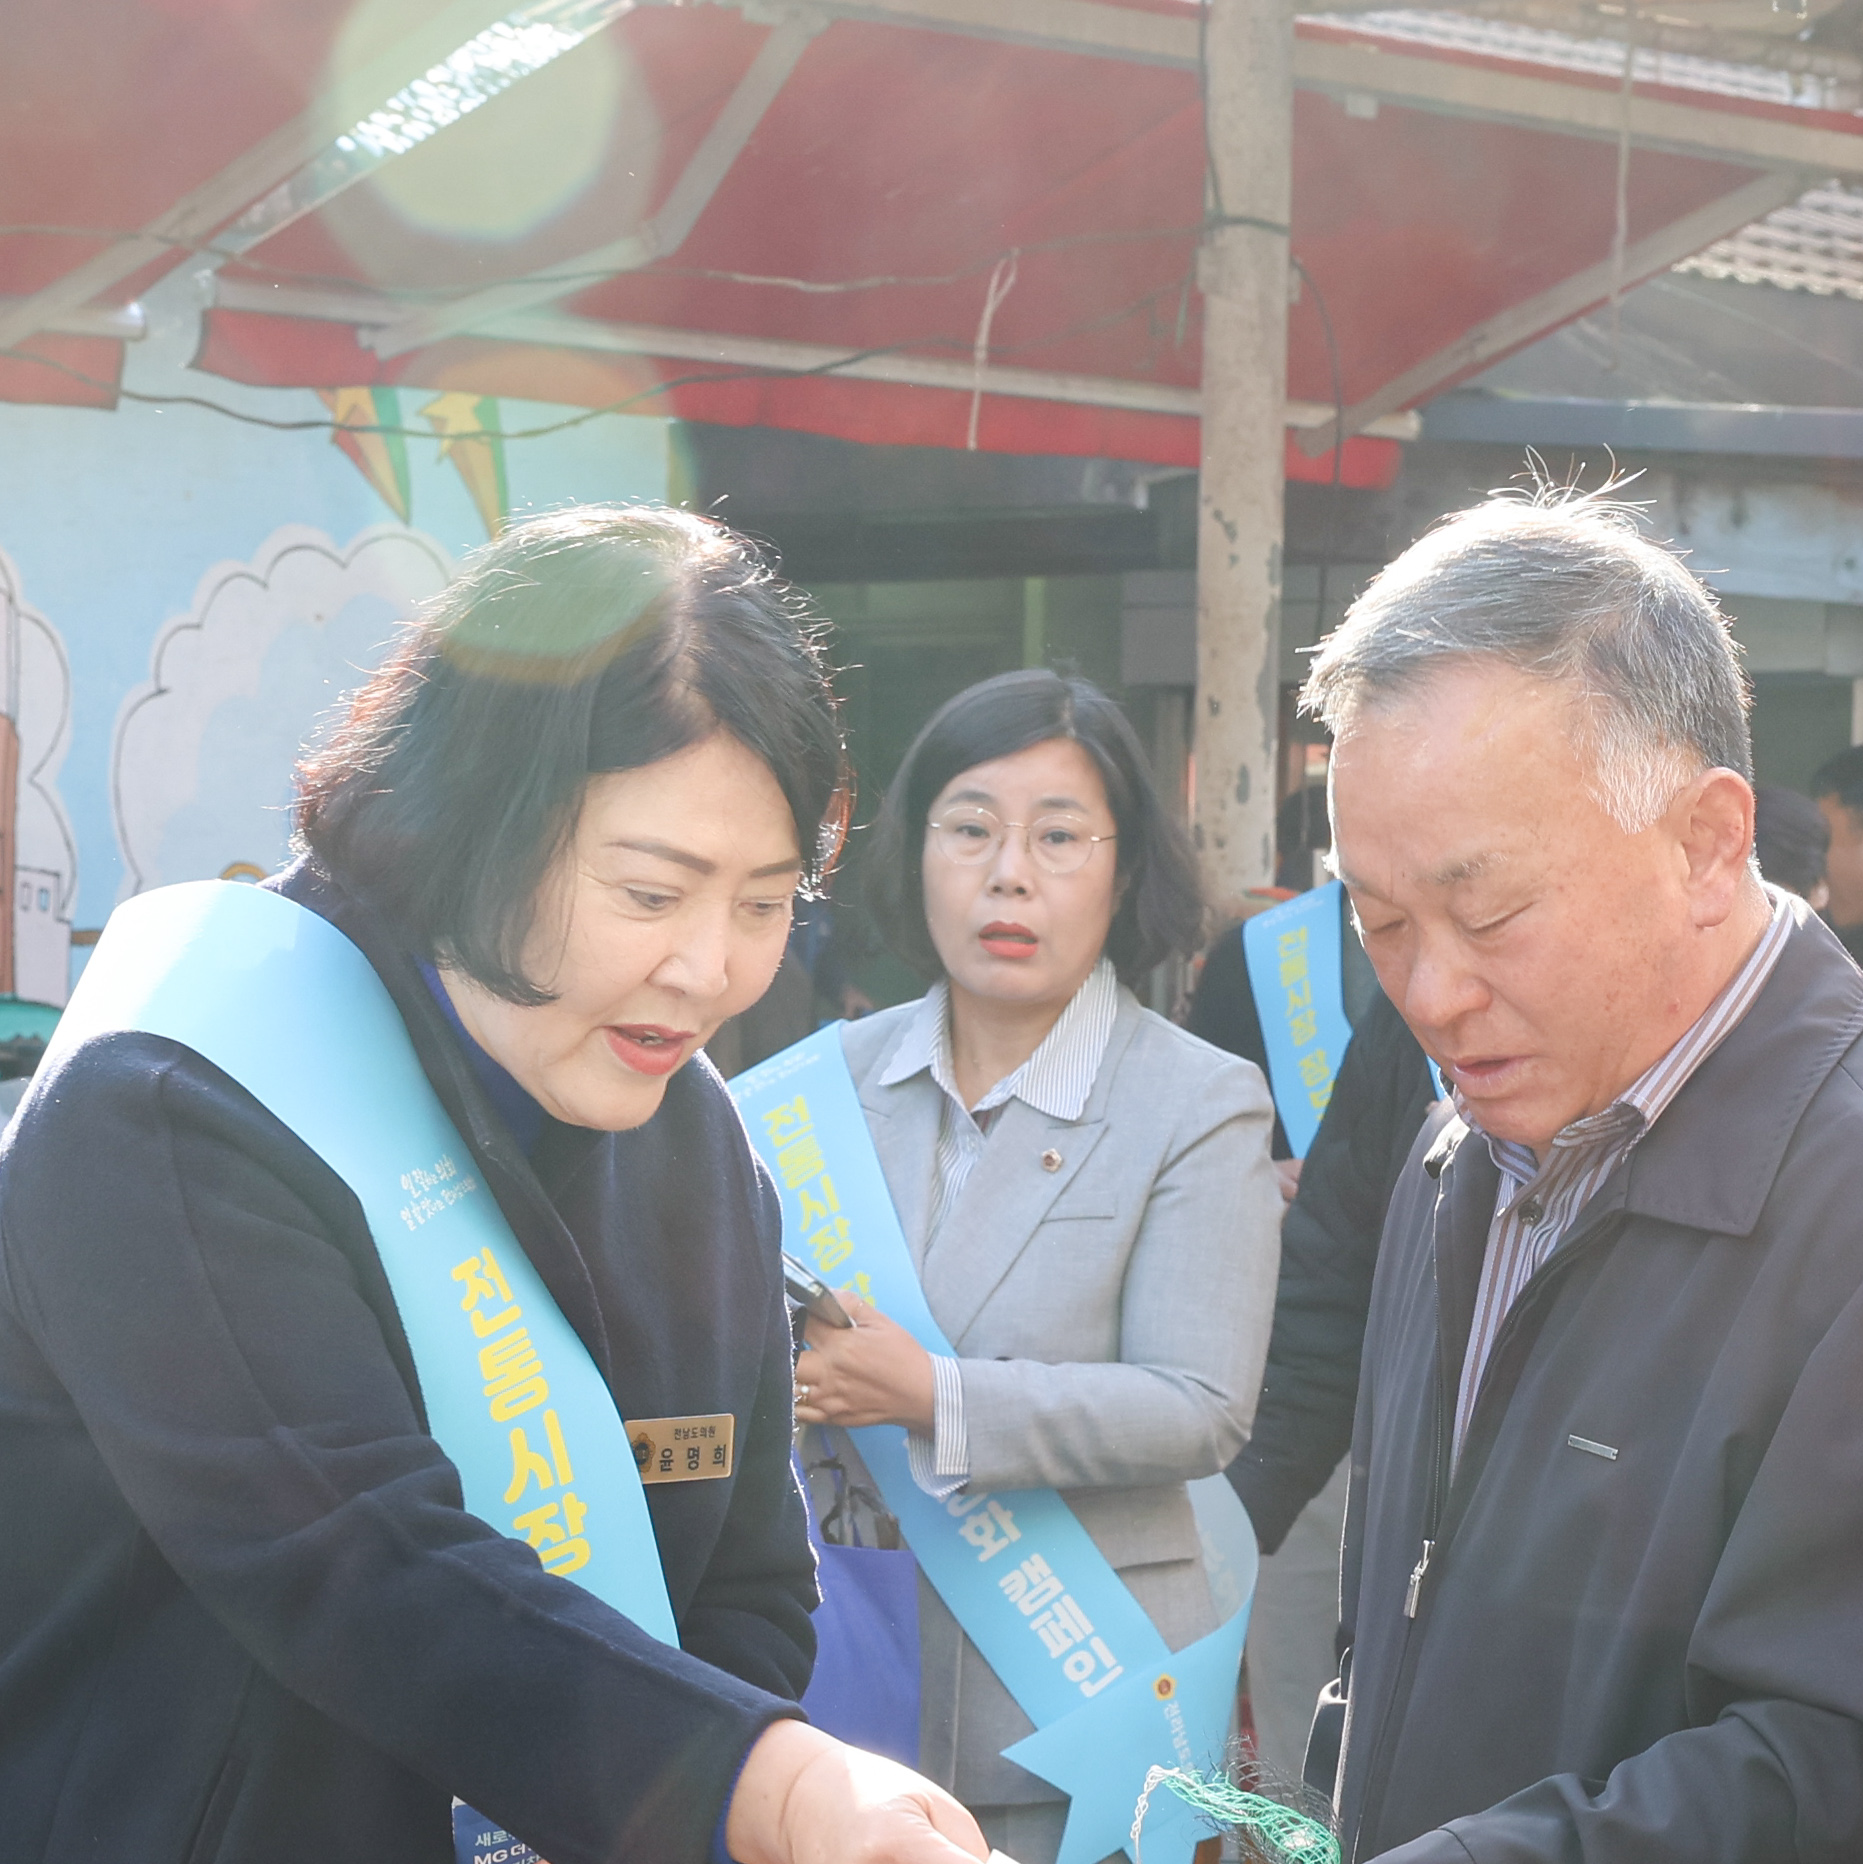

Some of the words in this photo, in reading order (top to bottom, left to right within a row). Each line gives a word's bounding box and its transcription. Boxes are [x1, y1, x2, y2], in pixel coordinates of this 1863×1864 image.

[762, 1095, 854, 1272] 전통시장
[451, 1246, 592, 1577] 전통시장
[997, 1553, 1125, 1698] 캠페인
